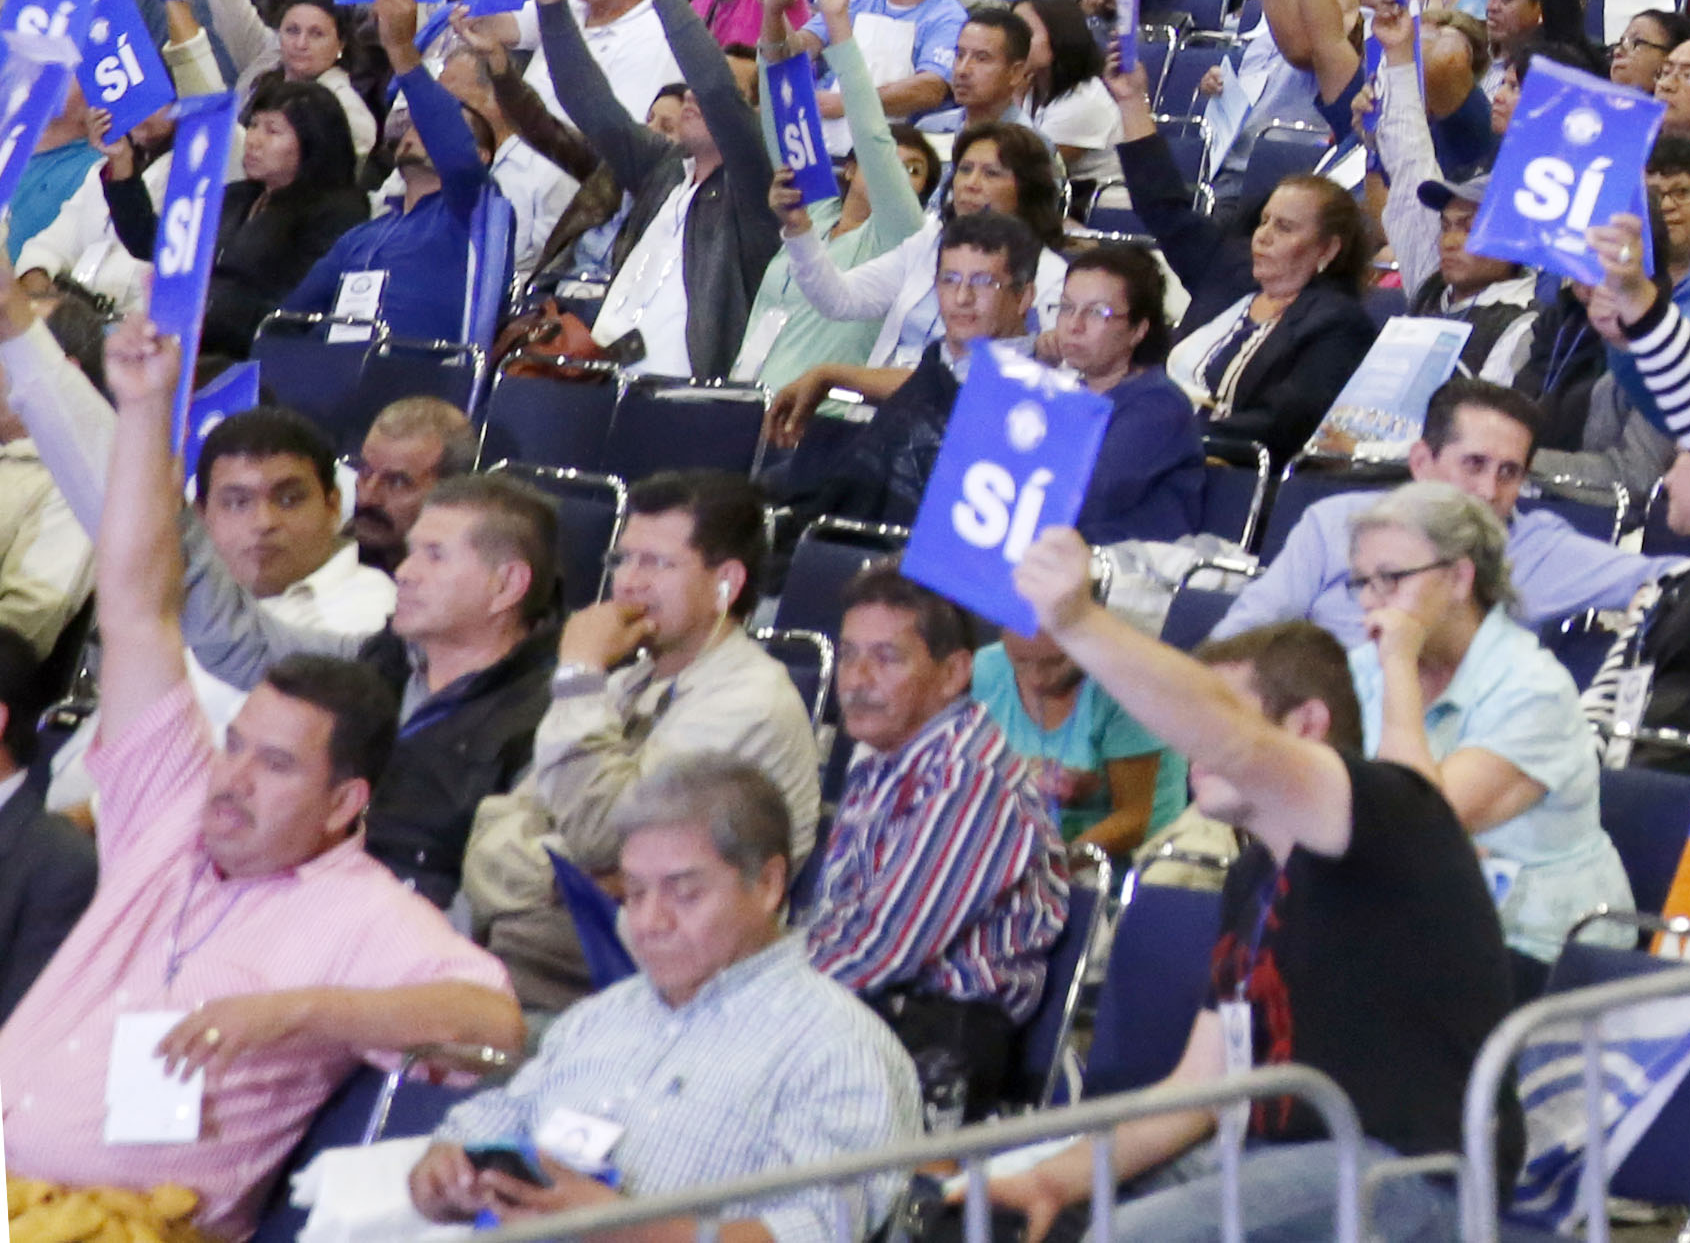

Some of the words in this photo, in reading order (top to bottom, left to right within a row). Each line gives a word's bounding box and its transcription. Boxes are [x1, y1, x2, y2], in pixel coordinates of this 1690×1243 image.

[95, 33, 144, 102] SÍ
[784, 107, 816, 170] SÍ
[160, 178, 209, 277] SÍ
[1515, 157, 1618, 240] SÍ
[953, 461, 1067, 578] SÍ
